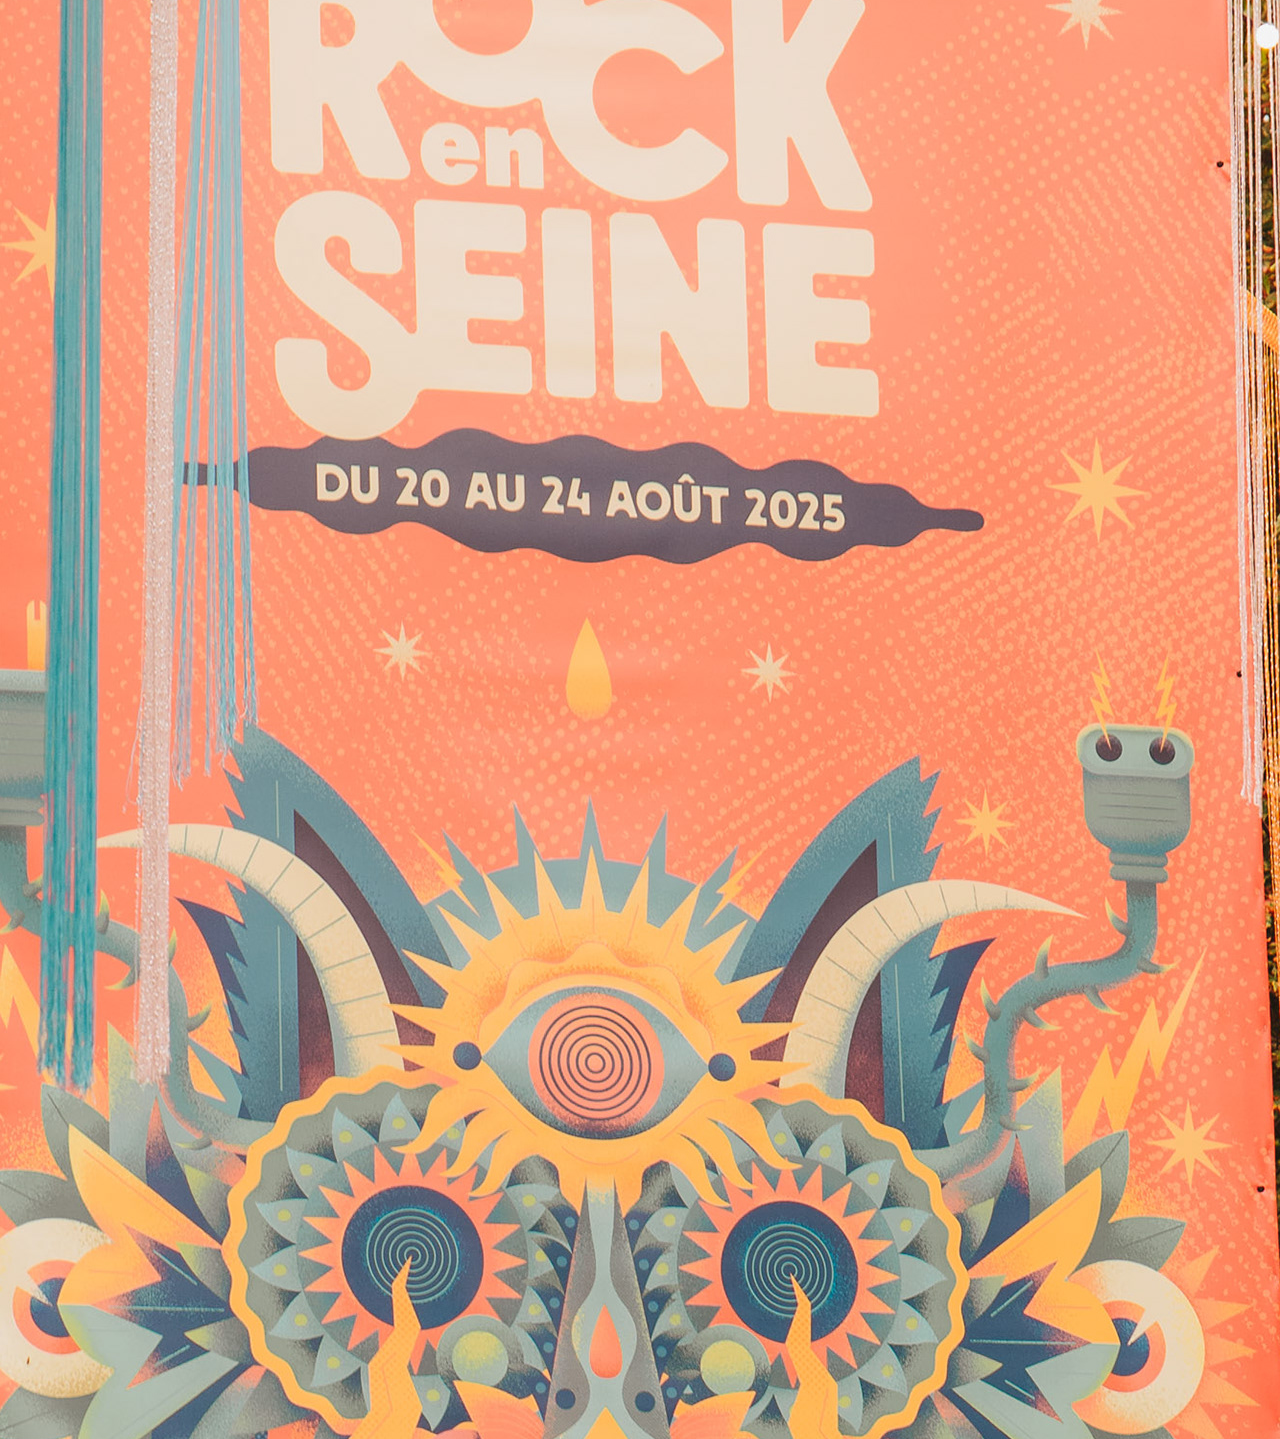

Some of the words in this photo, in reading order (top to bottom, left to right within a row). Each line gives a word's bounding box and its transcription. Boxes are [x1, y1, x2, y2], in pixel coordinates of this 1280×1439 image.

[420, 122, 545, 189] en
[274, 190, 880, 441] SEINE
[316, 462, 381, 505] DU
[395, 468, 451, 508] 20
[464, 472, 526, 513] AU
[541, 475, 591, 516] 24
[606, 473, 730, 525] AOÛT
[743, 488, 846, 532] 2025
